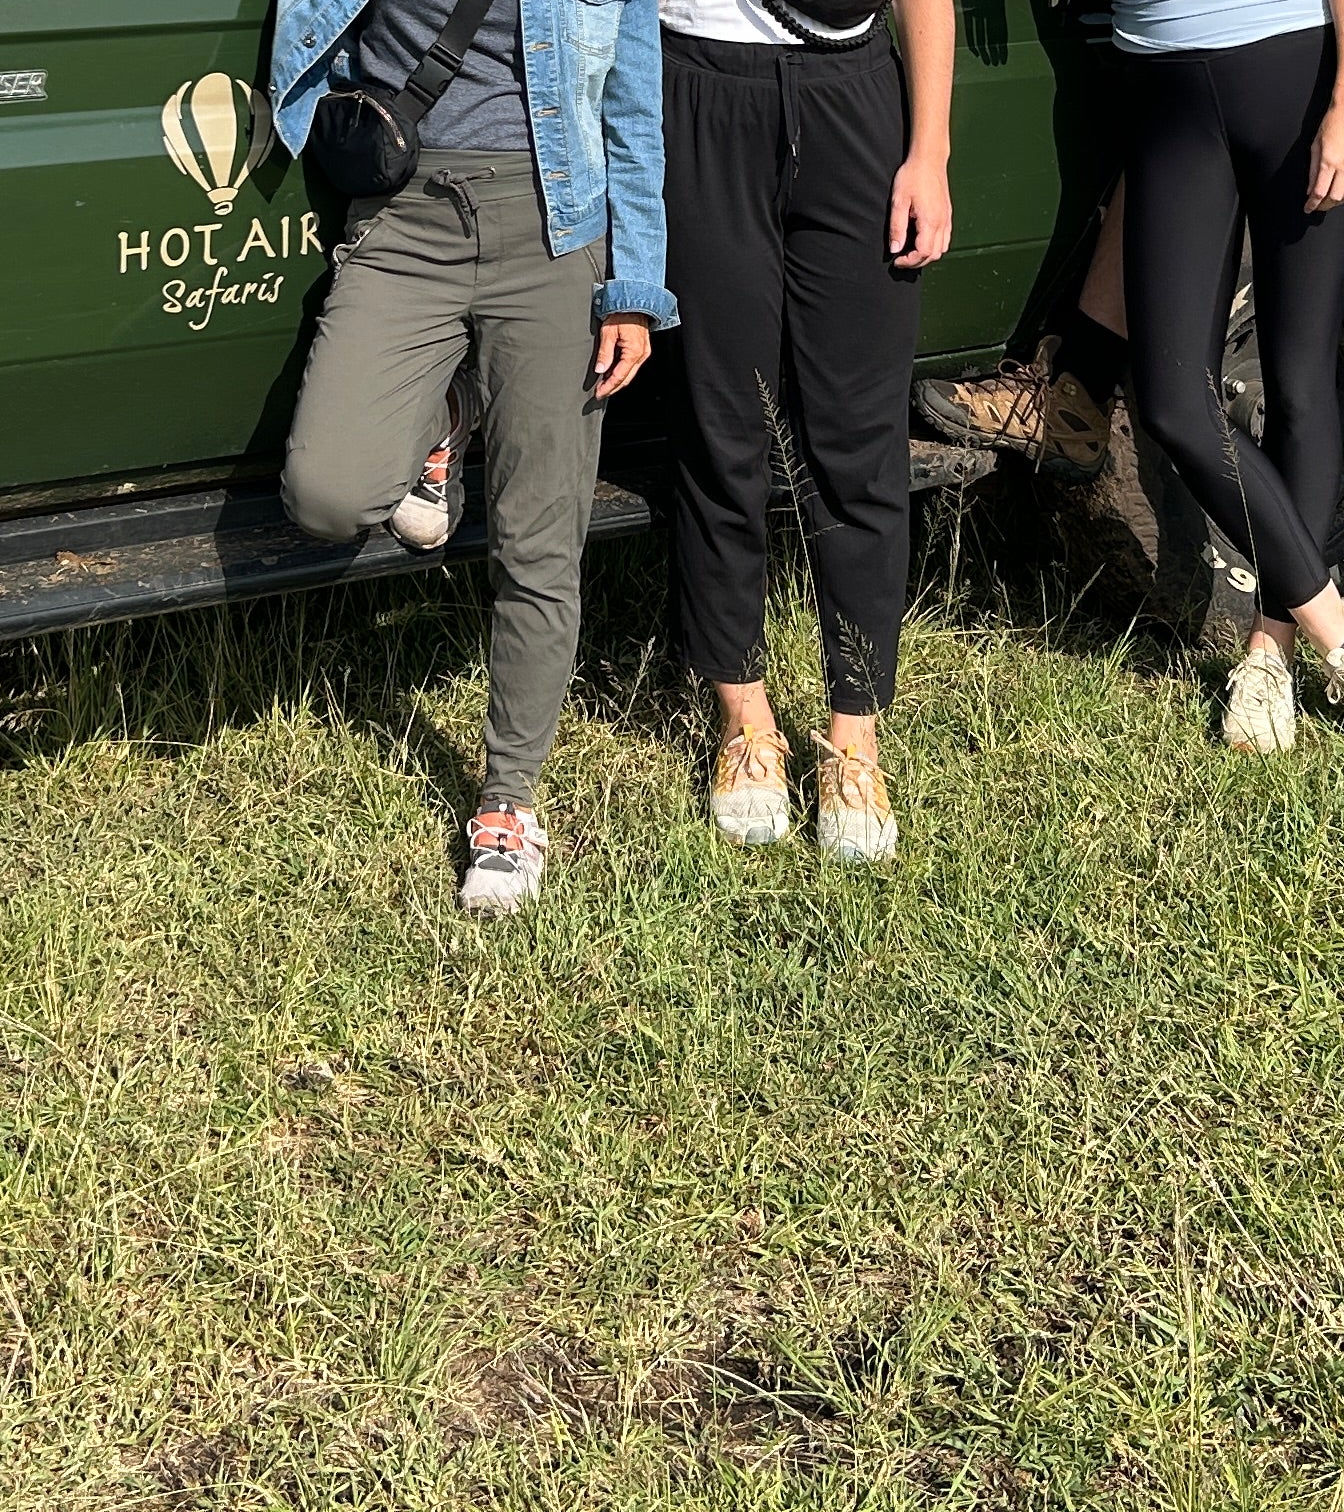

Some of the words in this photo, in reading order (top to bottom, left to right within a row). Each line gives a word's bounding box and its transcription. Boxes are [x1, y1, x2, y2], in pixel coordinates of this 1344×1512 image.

[118, 223, 223, 274] HOT
[237, 211, 324, 262] AIR
[162, 266, 285, 331] Safaris
